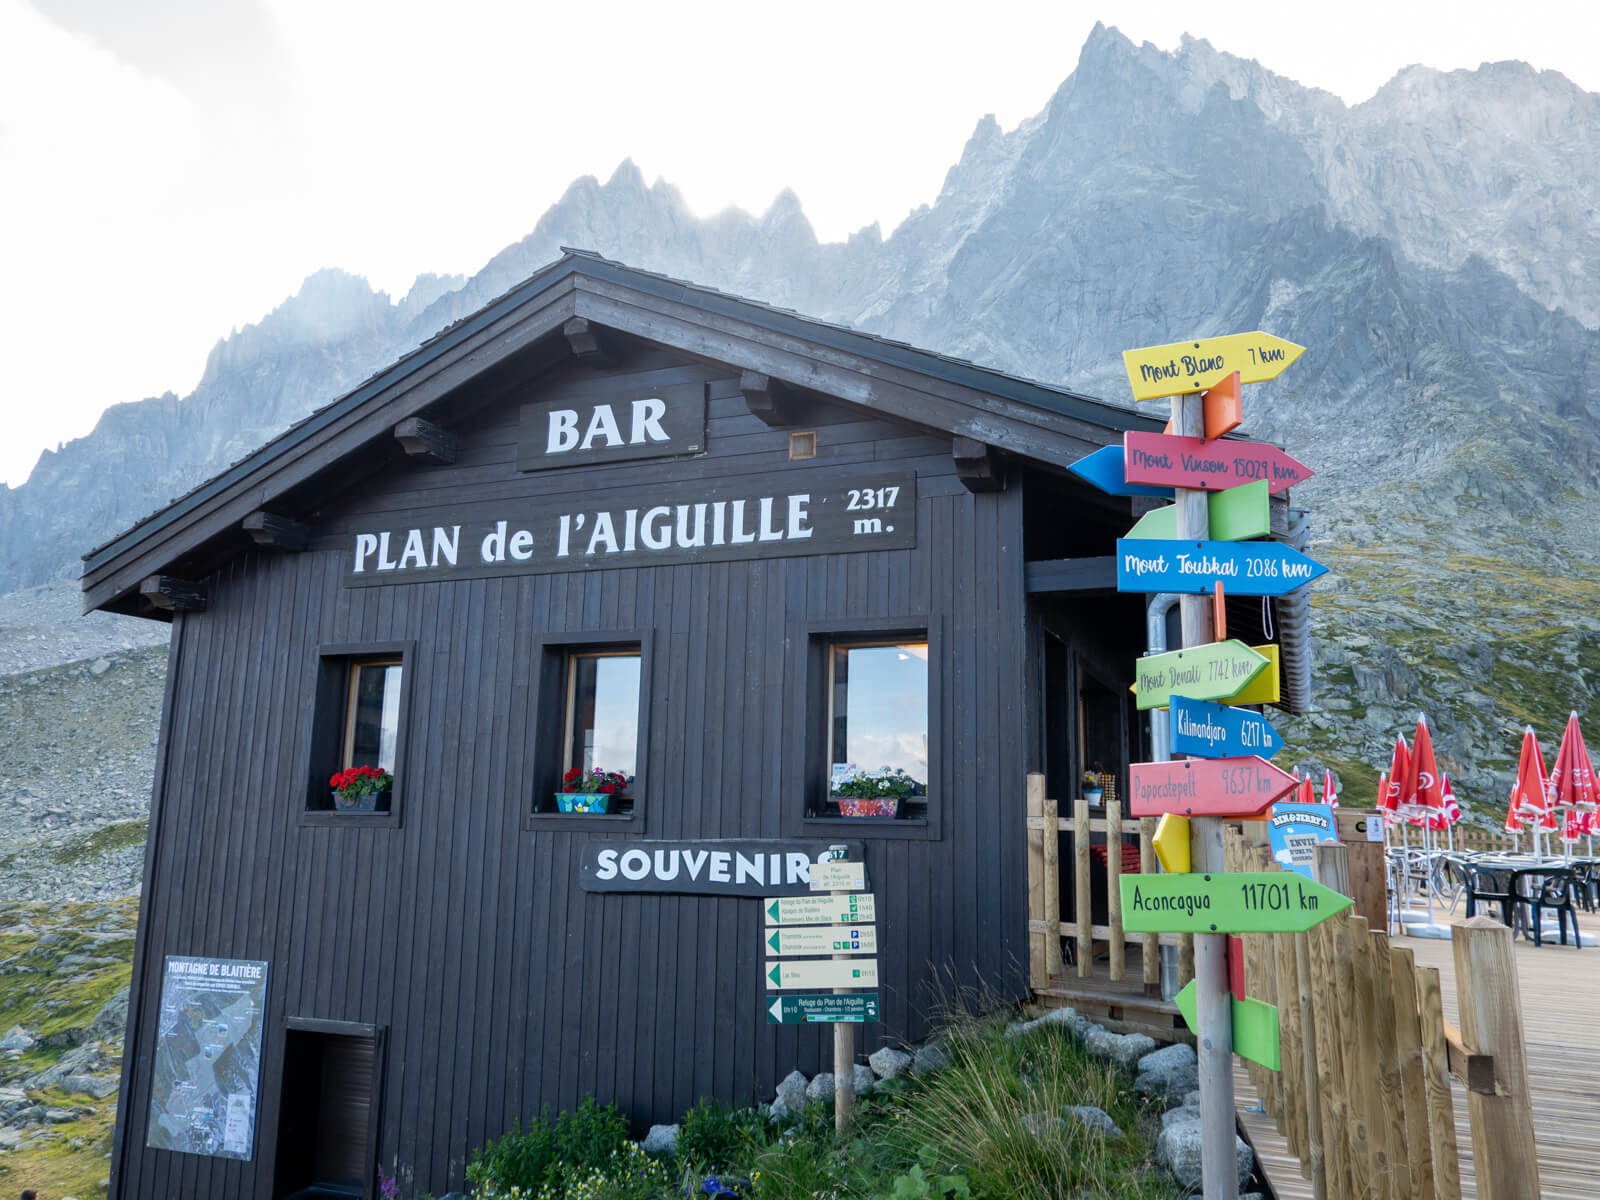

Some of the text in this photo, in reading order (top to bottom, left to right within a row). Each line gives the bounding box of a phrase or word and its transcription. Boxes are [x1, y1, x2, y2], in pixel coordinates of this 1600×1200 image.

[1139, 346, 1285, 383] Mont Blanc 7 km
[545, 398, 671, 454] BAR
[1132, 448, 1299, 481] Mont Vinson 15029 km
[846, 486, 900, 511] 2317
[353, 493, 813, 573] PLAN de l'AIGUILLE
[852, 517, 895, 536] m.
[1124, 553, 1312, 578] Mont Toubkal 2086 km
[1140, 656, 1253, 693] Mont Denali 7742 km
[1177, 709, 1272, 748] Kilimandjaro 6217 km
[1221, 767, 1252, 795] 9637
[1256, 766, 1271, 793] km
[1133, 882, 1319, 917] Aconcagua 11701 km
[168, 960, 209, 975] MONTAGNE
[209, 963, 221, 976] DE
